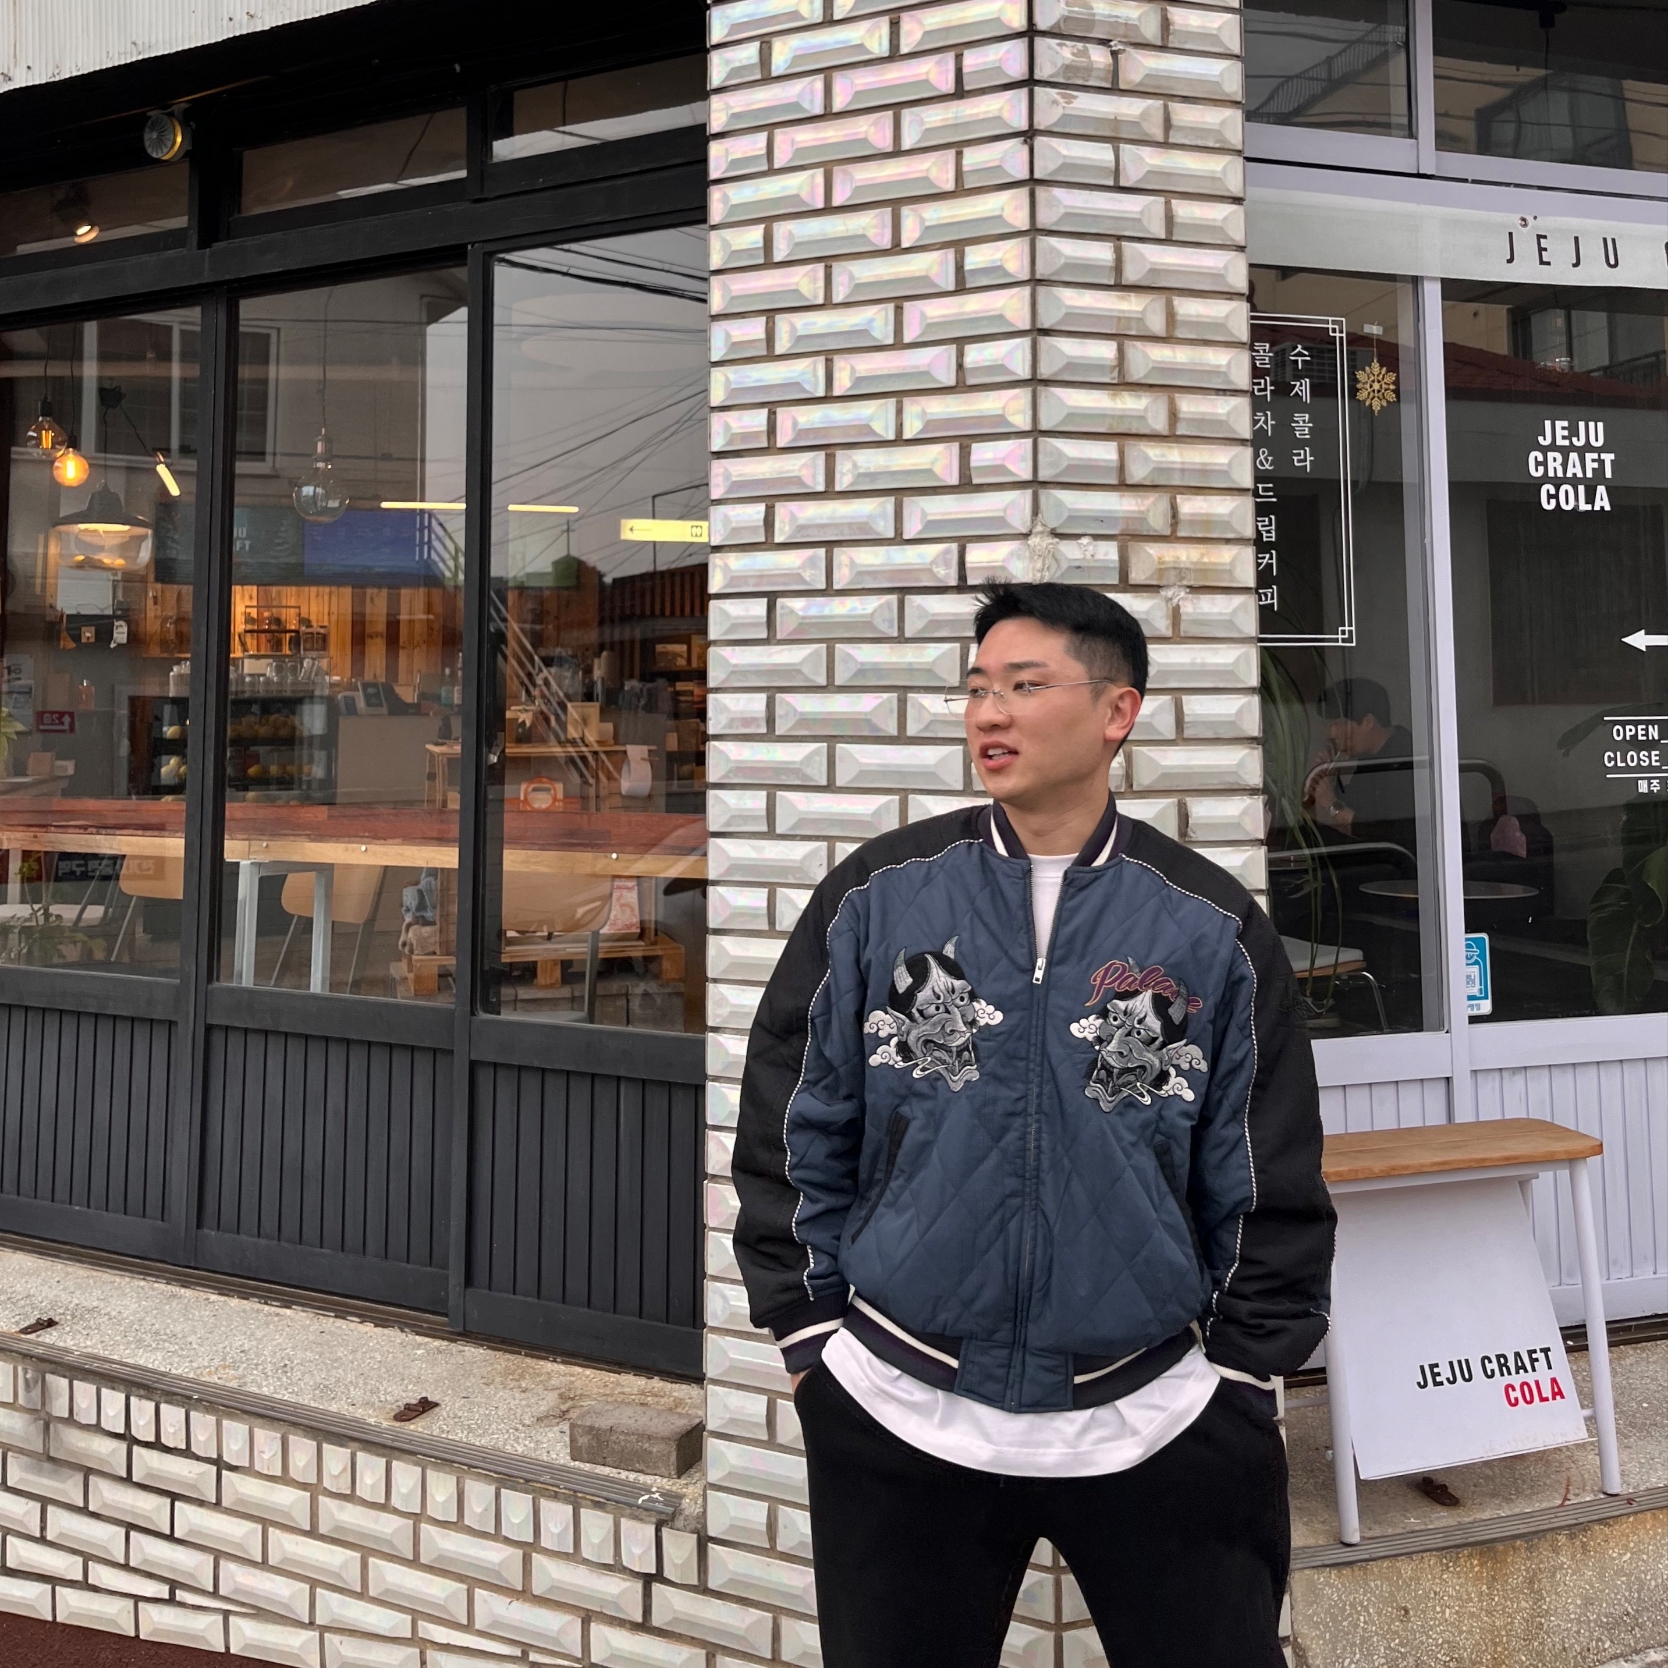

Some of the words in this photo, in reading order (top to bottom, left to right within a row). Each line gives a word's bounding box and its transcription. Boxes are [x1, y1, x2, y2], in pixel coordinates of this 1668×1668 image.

[1506, 231, 1619, 269] JEJU
[1537, 420, 1605, 447] JEJU
[1528, 451, 1615, 479] CRAFT
[1540, 483, 1612, 511] COLA
[1637, 779, 1660, 793] 매주
[1416, 1358, 1473, 1390] JEJU
[1480, 1346, 1553, 1379] CRAFT
[1504, 1376, 1566, 1408] COLA
